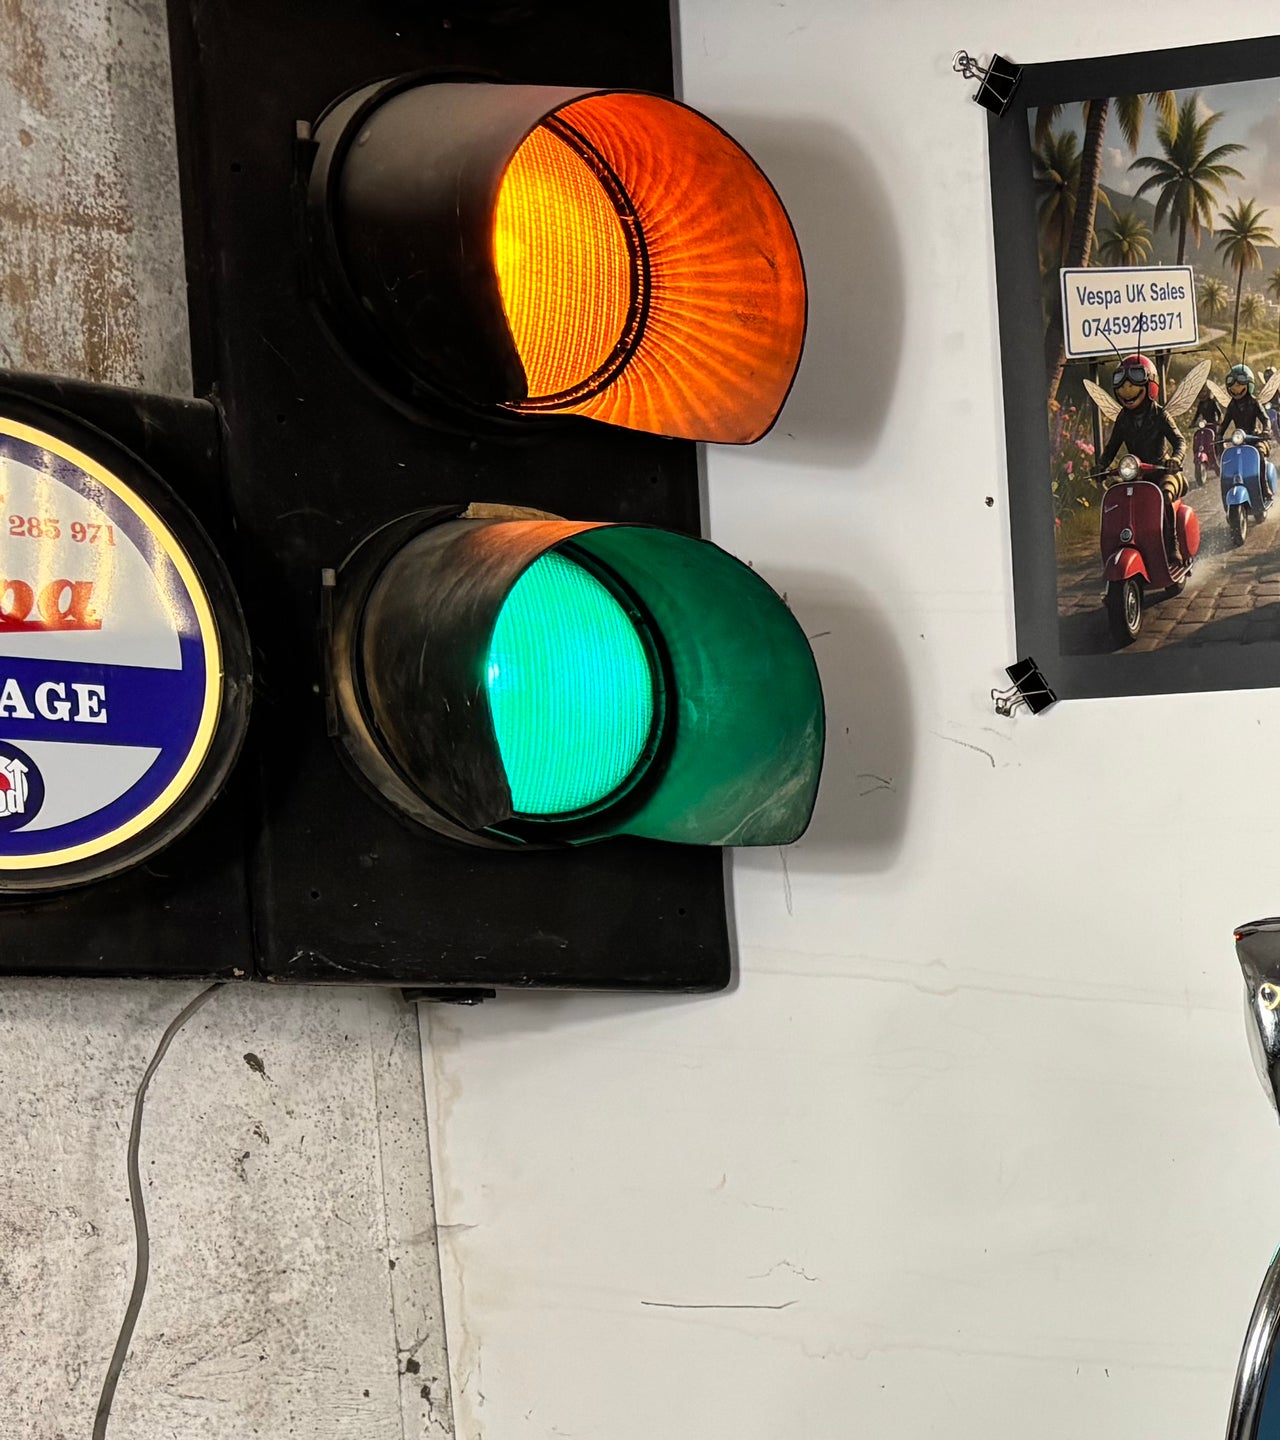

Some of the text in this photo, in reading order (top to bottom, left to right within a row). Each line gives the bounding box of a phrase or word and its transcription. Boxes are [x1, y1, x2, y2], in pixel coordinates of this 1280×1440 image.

[1076, 281, 1185, 310] Vespa UK Sales
[1081, 311, 1183, 338] 07459285971
[8, 514, 116, 547] 285 971
